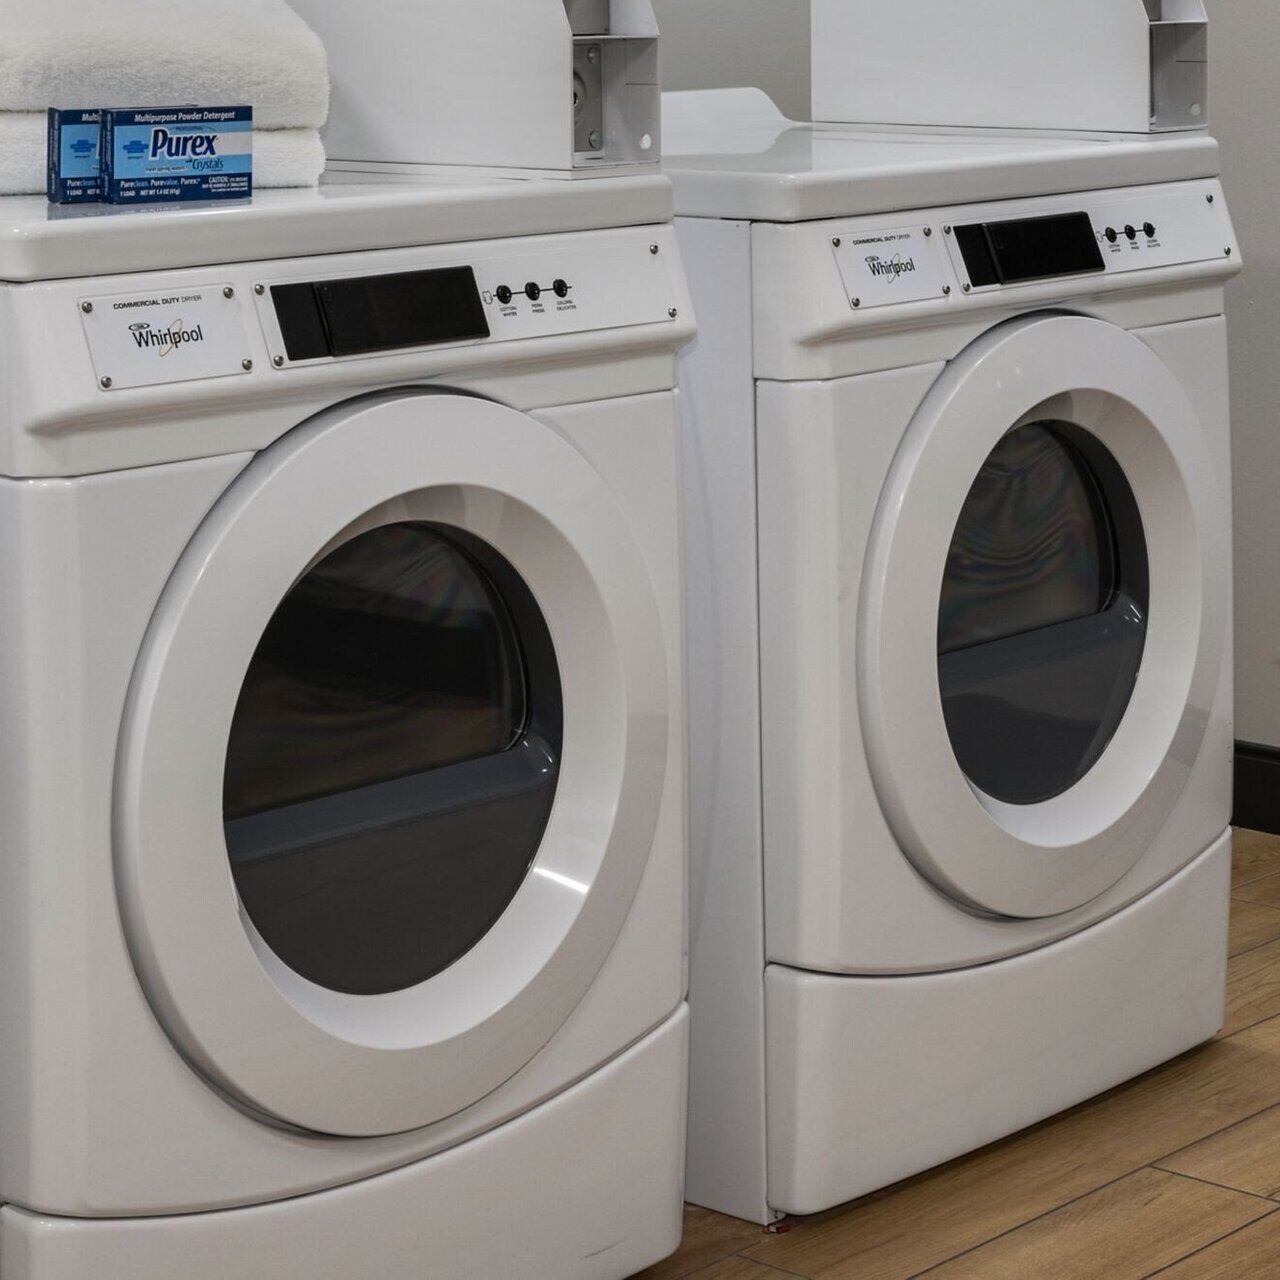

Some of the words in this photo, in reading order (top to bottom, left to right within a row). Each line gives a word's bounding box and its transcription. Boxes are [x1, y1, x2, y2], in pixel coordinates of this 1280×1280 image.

[134, 114, 178, 123] Multipurpose
[178, 112, 202, 121] Powder
[203, 111, 236, 121] Detergent
[151, 129, 217, 158] Purex
[192, 158, 224, 171] Crystals
[867, 257, 916, 277] Whirlpool
[113, 299, 160, 310] COMMERCIAL
[181, 294, 202, 302] DRYER
[132, 324, 203, 349] Whirlpool
